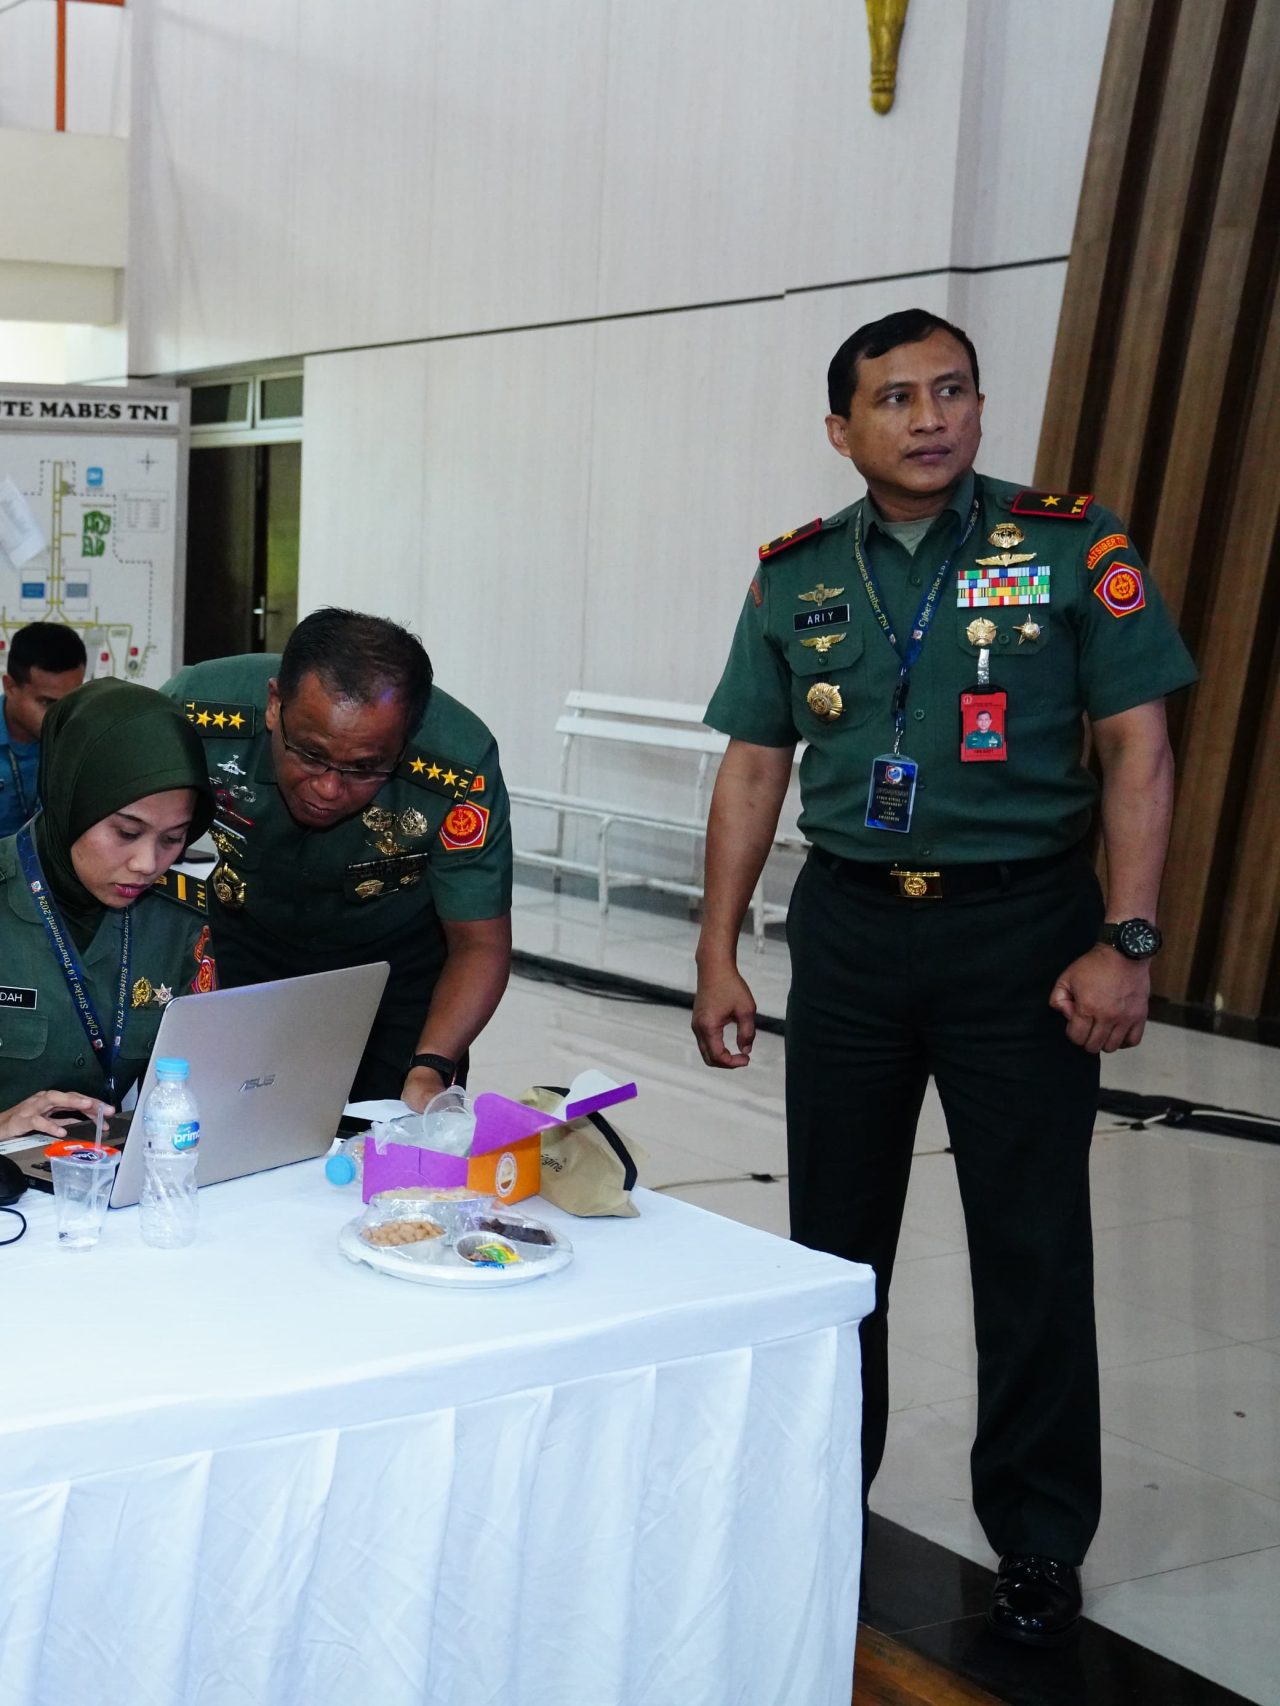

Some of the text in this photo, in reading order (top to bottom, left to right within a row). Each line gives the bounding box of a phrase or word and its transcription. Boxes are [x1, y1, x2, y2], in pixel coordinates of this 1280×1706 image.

[39, 401, 121, 419] MABES
[127, 404, 169, 421] TNI
[1071, 496, 1089, 513] TNI
[918, 603, 932, 627] Cyber
[927, 577, 941, 602] Strike
[807, 611, 834, 625] ARIY
[878, 613, 890, 631] TNI
[186, 701, 195, 722] TN
[454, 768, 474, 799] TNI
[197, 883, 206, 908] TNI
[47, 915, 73, 968] Tournament
[73, 982, 88, 1010] Strike
[118, 966, 128, 1008] Satsiber
[84, 1011, 99, 1036] Cyber
[117, 1010, 125, 1029] TNI
[239, 1074, 276, 1092] ASUS
